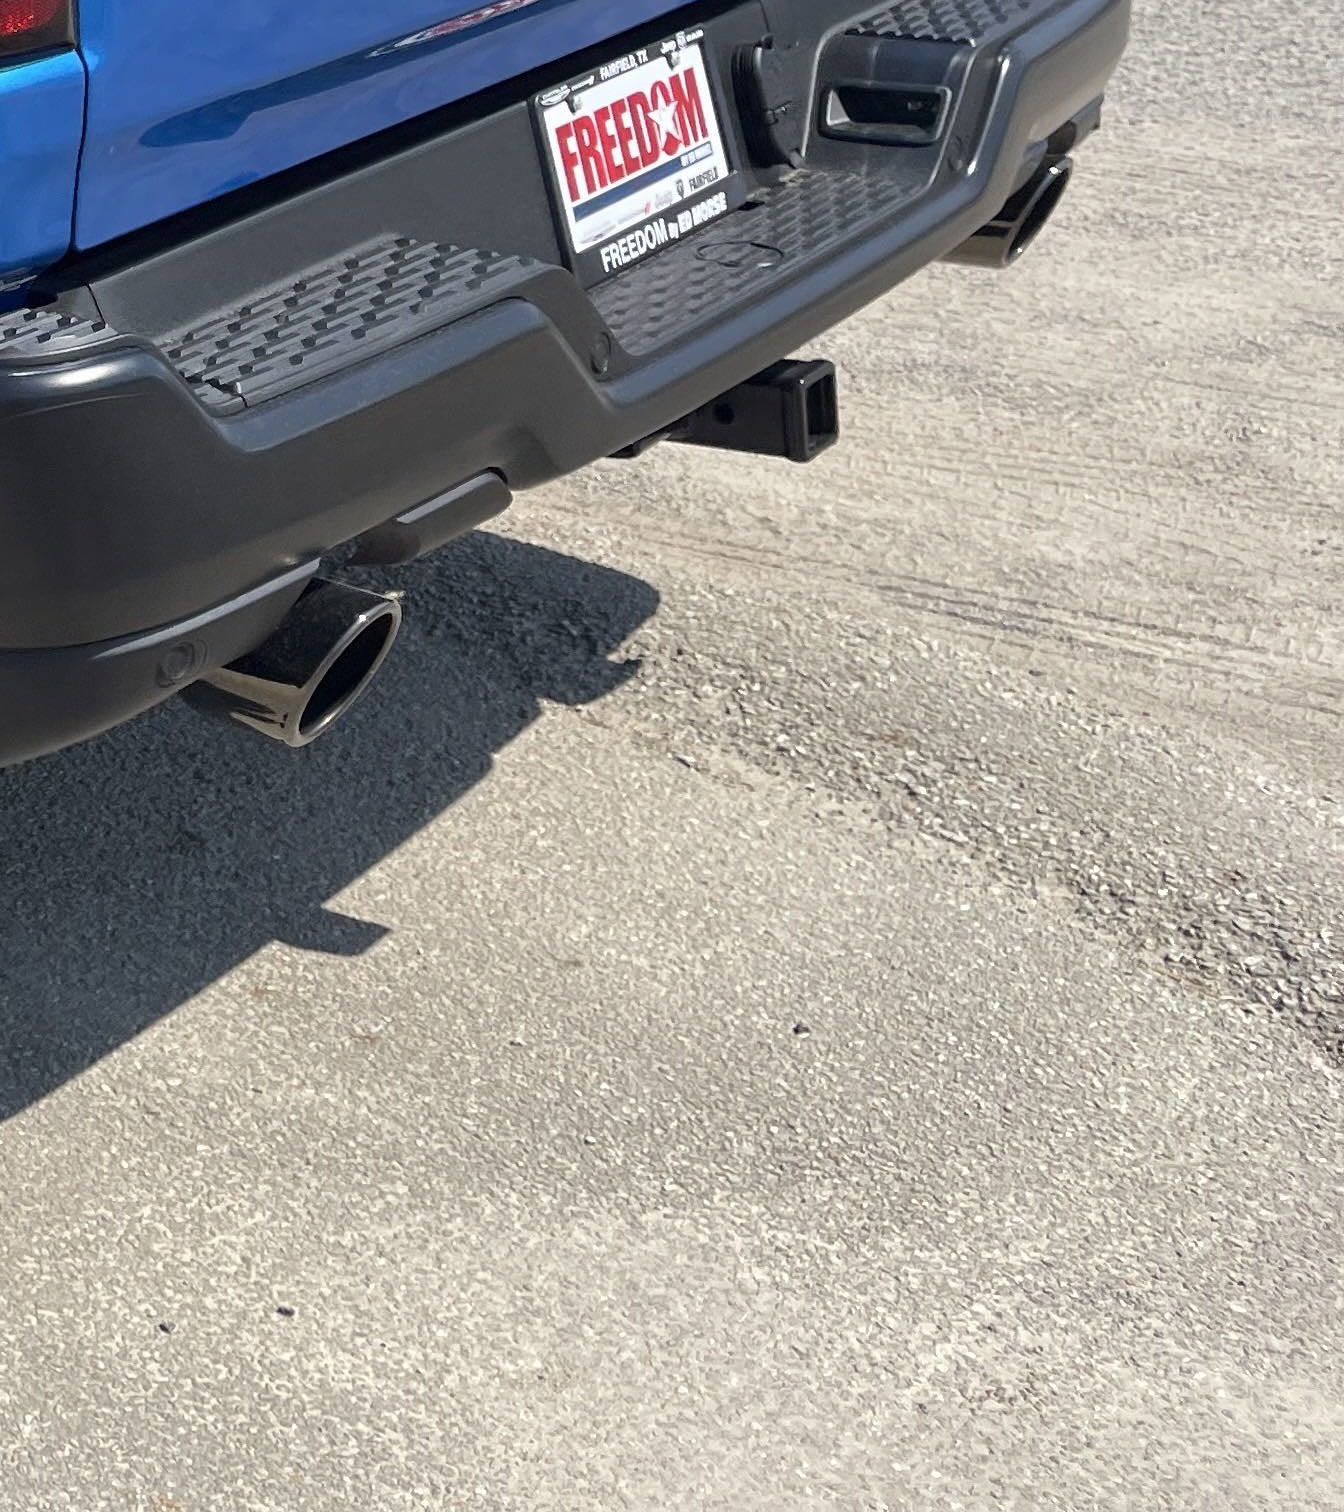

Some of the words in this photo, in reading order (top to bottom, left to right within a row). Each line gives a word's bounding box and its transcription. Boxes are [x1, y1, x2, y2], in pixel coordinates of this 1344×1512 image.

[554, 67, 710, 203] FREEDOM
[600, 217, 669, 273] FREEDOM
[677, 210, 693, 234] ED
[691, 191, 728, 226] MORSE
